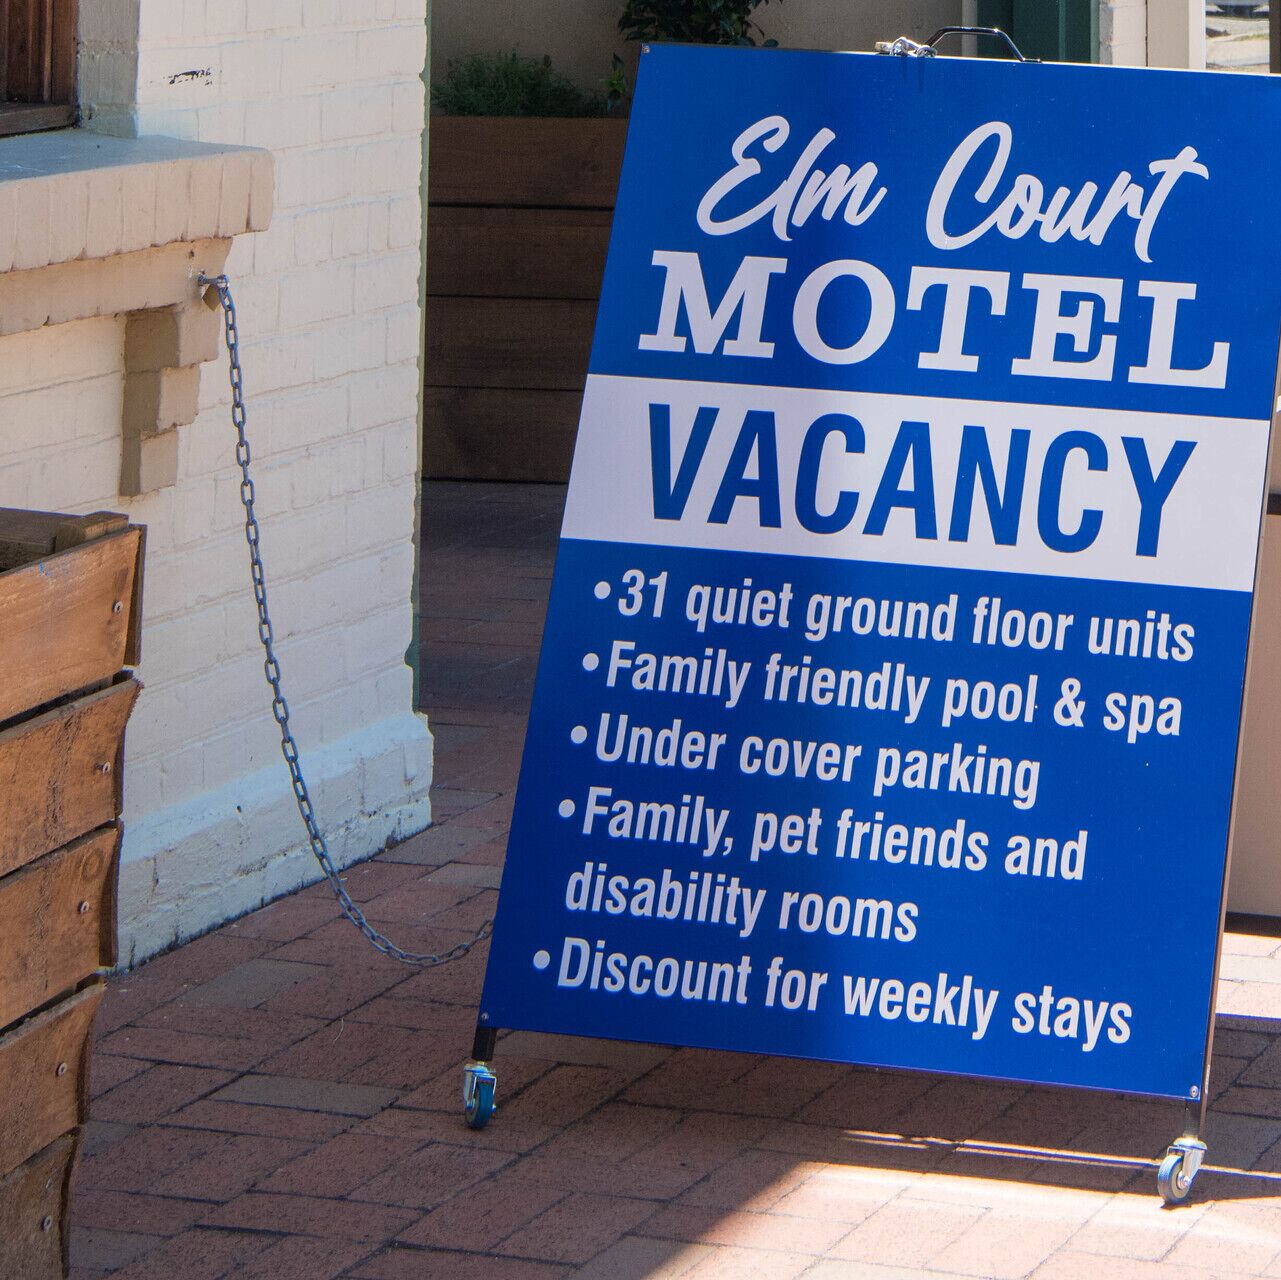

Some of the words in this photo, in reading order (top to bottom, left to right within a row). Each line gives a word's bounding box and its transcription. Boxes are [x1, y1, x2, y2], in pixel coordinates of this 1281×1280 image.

[695, 114, 888, 243] Elm
[925, 120, 1211, 264] Court
[638, 249, 1231, 390] MOTEL
[648, 402, 1198, 558] VACANCY
[617, 569, 668, 619] 31
[685, 577, 794, 633] quiet
[804, 593, 959, 643] ground
[972, 596, 1075, 651] floor
[1087, 609, 1196, 662] units
[606, 640, 752, 708] Family
[764, 652, 931, 725] friendly
[942, 674, 1039, 728] pool
[1052, 677, 1087, 728] &
[1103, 691, 1183, 744] spa
[596, 712, 727, 770] Under
[739, 733, 863, 782] cover
[873, 742, 1041, 810] parking
[582, 786, 734, 858] Family,
[750, 807, 823, 862] pet
[836, 813, 989, 872] friends
[1004, 829, 1089, 881] and
[565, 861, 763, 938] disability
[778, 891, 919, 942] rooms
[557, 937, 752, 1005] Discount
[765, 956, 829, 1011] for
[843, 972, 1000, 1042] weekly
[1011, 985, 1133, 1053] stays
